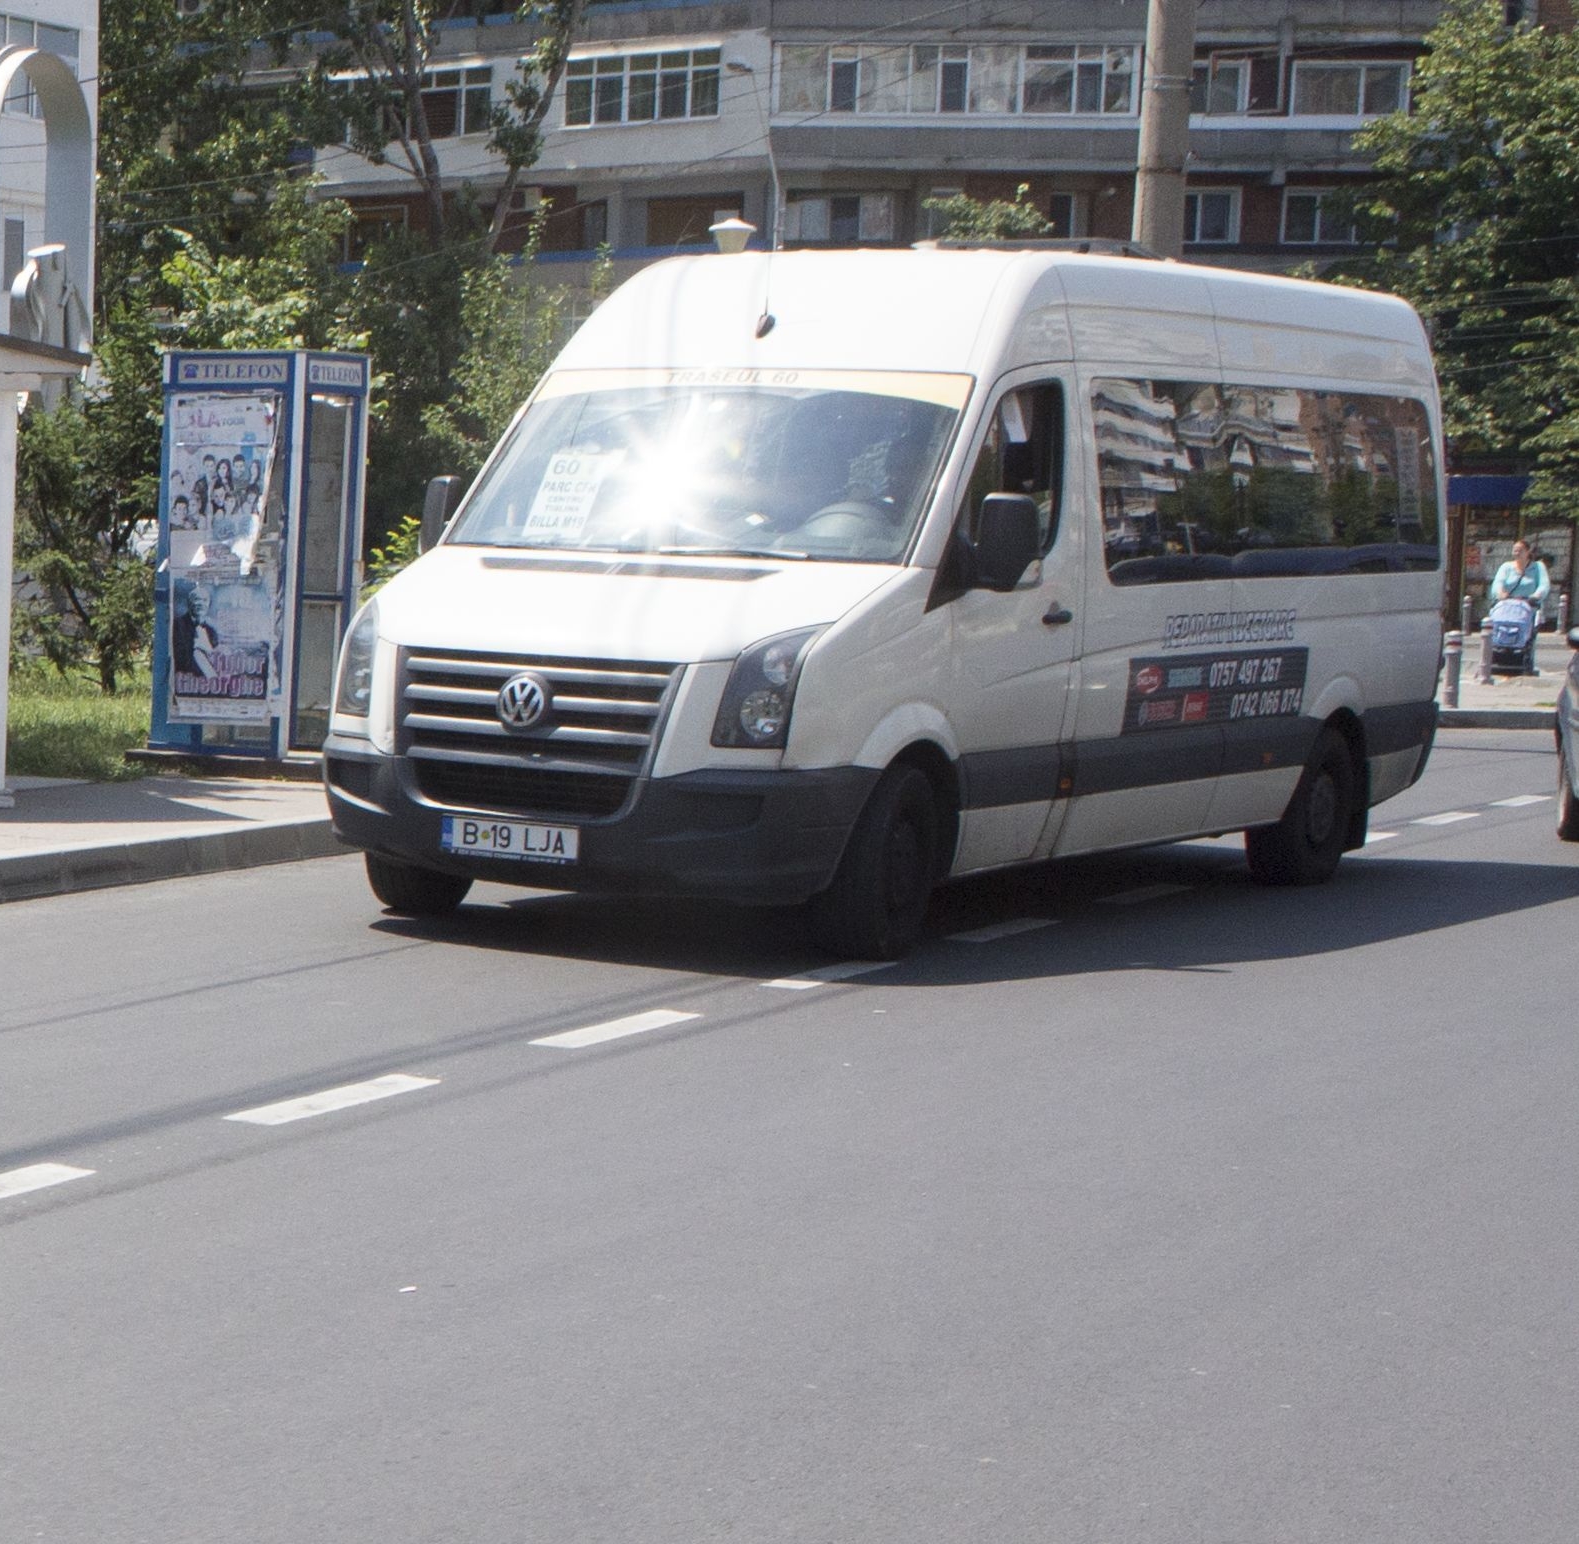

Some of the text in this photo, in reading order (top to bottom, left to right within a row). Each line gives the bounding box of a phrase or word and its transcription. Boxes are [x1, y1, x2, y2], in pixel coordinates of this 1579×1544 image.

[203, 364, 284, 379] TELEFON
[320, 366, 362, 381] TELEFON
[667, 369, 799, 384] TRASEUL 60
[553, 459, 581, 476] 60
[542, 480, 572, 493] PARC
[529, 515, 559, 529] BILLA
[1209, 660, 1238, 688] 0757
[1238, 659, 1260, 685] 497
[1260, 657, 1283, 683] 267
[1229, 692, 1259, 720] 0742
[1280, 687, 1302, 714] 874
[463, 821, 565, 854] B 19 LJA
